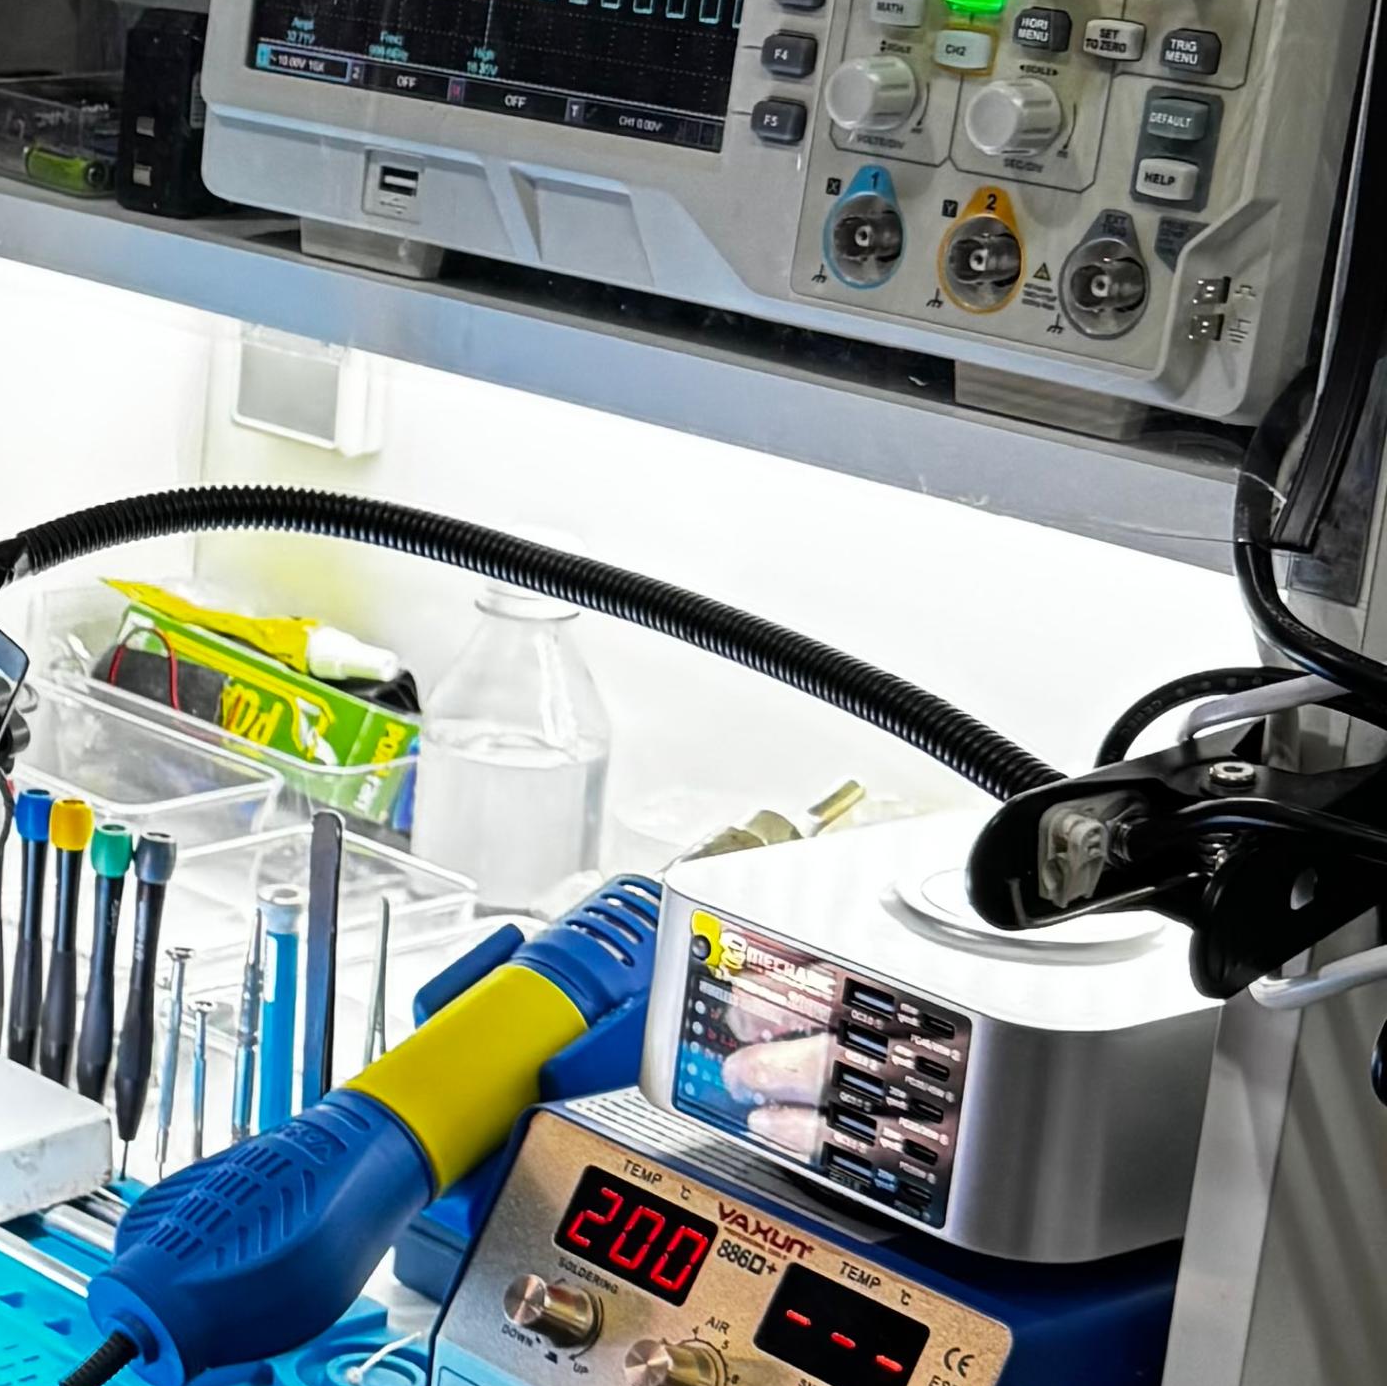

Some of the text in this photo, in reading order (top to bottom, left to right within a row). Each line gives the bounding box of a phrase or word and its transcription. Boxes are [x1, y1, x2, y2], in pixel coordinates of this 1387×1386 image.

[877, 0, 904, 15] MATH
[1020, 16, 1050, 30] HORI
[1017, 27, 1050, 43] MENU
[1099, 27, 1120, 40] SET
[944, 43, 967, 57] CH2
[1085, 37, 1127, 54] TO ZERO
[1169, 38, 1198, 53] TRIG
[773, 47, 789, 62] F4
[1164, 50, 1199, 65] MENU
[396, 74, 418, 89] OFF
[504, 93, 528, 109] OFF
[762, 114, 778, 128] F5
[1149, 110, 1193, 129] DEFAULT
[870, 170, 880, 190] 1
[1144, 171, 1176, 187] HELP
[985, 193, 997, 212] 2
[622, 1160, 663, 1185] TEMP
[566, 1186, 709, 1292] 200
[558, 1257, 619, 1295] SOLDERING
[838, 1260, 882, 1290] TEMP
[705, 1315, 731, 1335] AIR
[500, 1323, 535, 1348] DOWN
[572, 1363, 590, 1376] UP
[943, 1346, 976, 1378] CE
